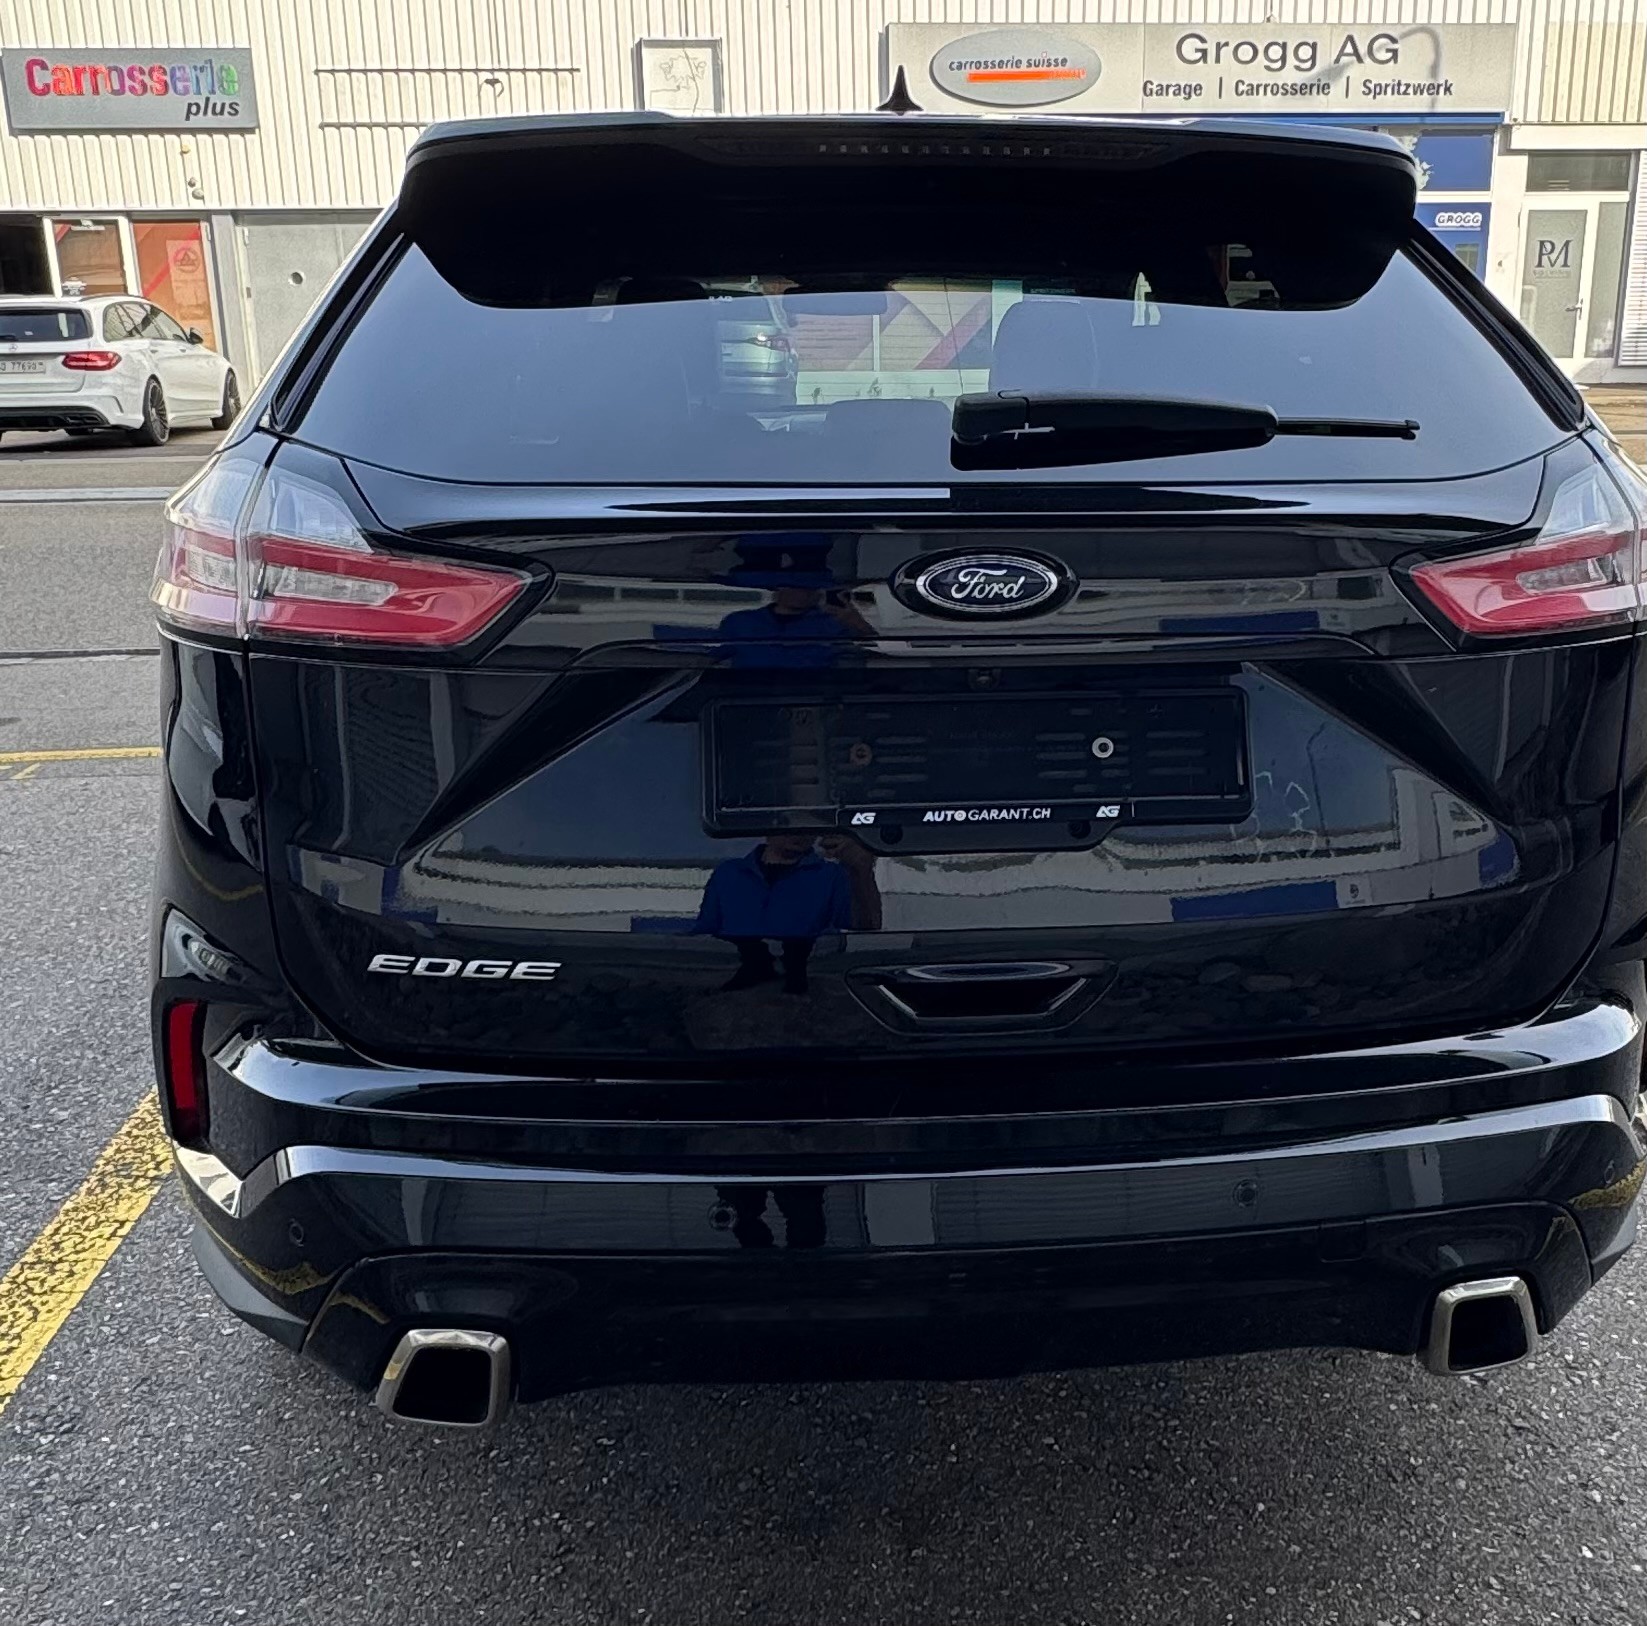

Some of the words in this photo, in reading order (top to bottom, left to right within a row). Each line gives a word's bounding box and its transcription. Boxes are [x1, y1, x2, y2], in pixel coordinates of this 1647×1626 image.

[948, 56, 1023, 71] carrosserie
[1025, 56, 1068, 68] suisse
[1176, 33, 1318, 72] Grogg
[1333, 34, 1399, 64] AG
[1142, 80, 1203, 100] Garage
[1234, 79, 1331, 96] Carrosserie
[1362, 79, 1453, 98] Spritzwerk
[185, 97, 240, 121] plus
[1437, 214, 1481, 224] GROGG
[951, 568, 1025, 599] Ford
[367, 954, 562, 980] EDGE
